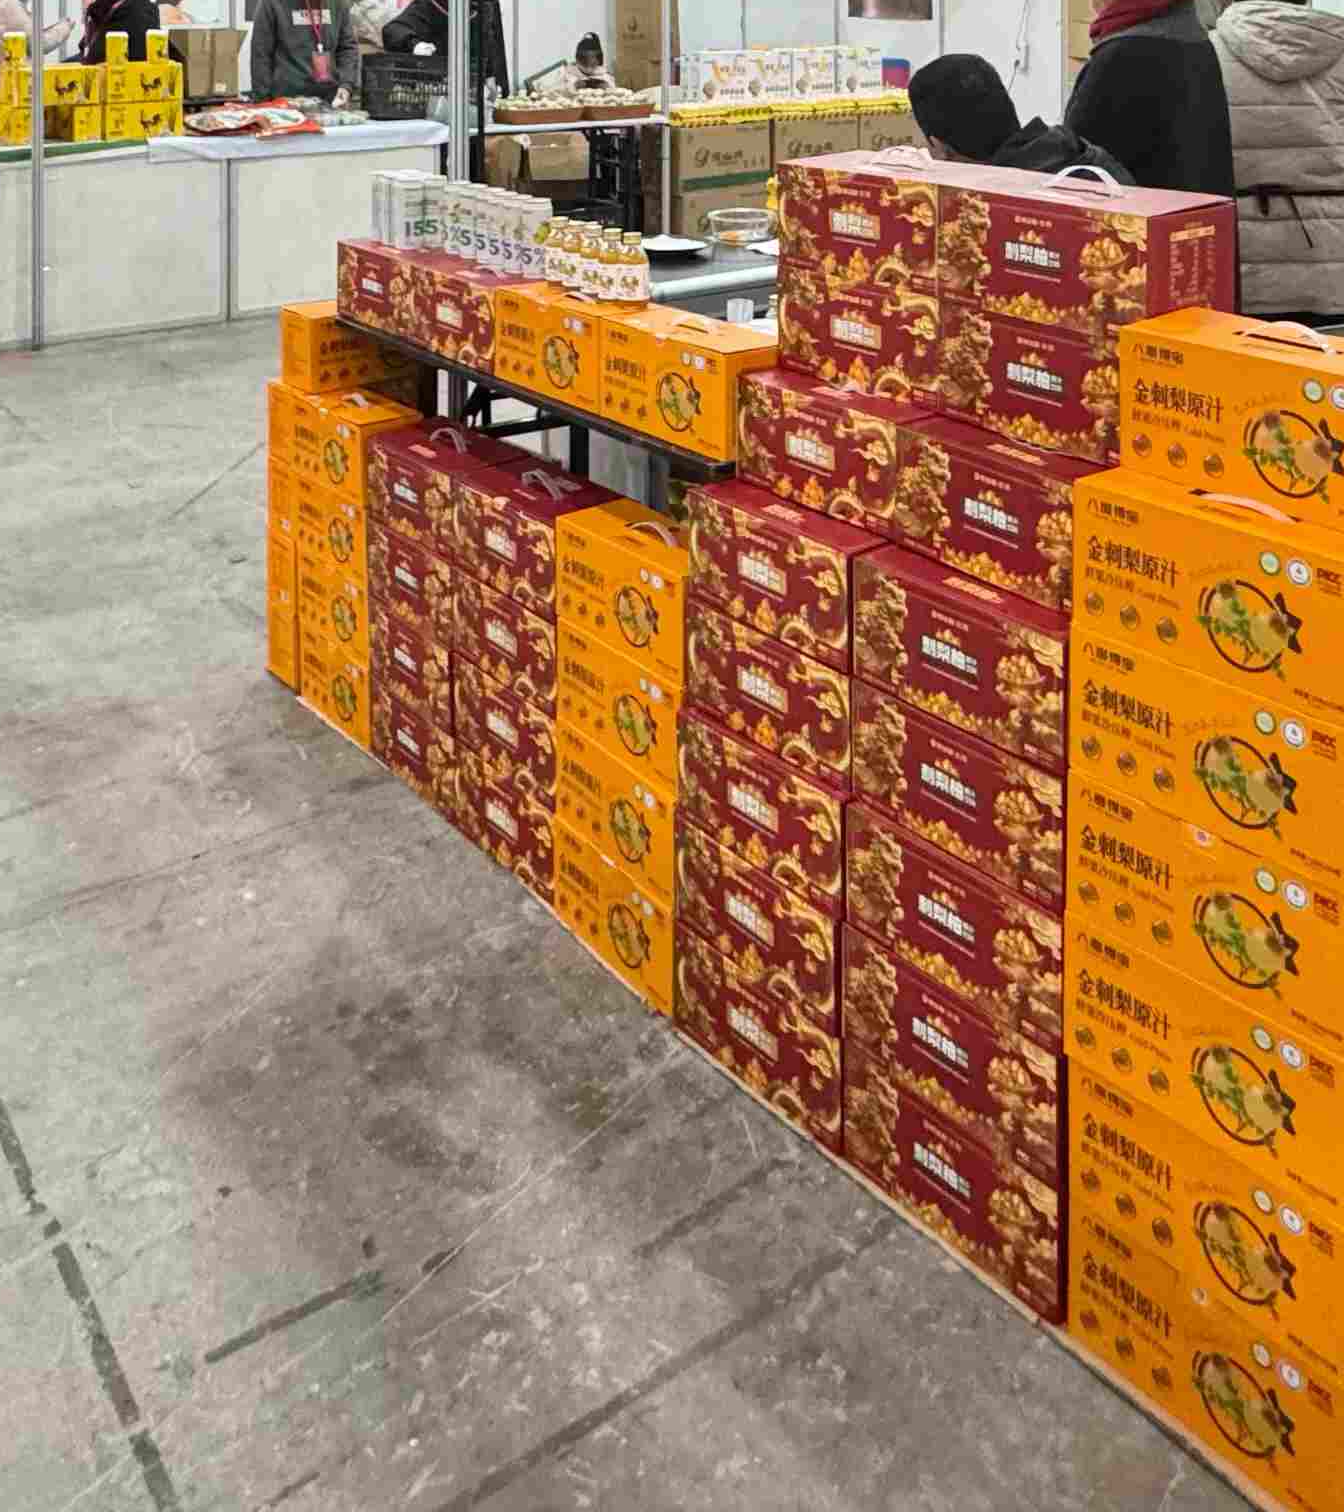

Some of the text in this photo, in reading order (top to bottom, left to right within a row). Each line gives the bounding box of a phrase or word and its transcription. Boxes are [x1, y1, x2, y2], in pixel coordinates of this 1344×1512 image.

[1132, 377, 1225, 424] 金刺梨原汁
[1087, 535, 1180, 589] 金刺梨原汁
